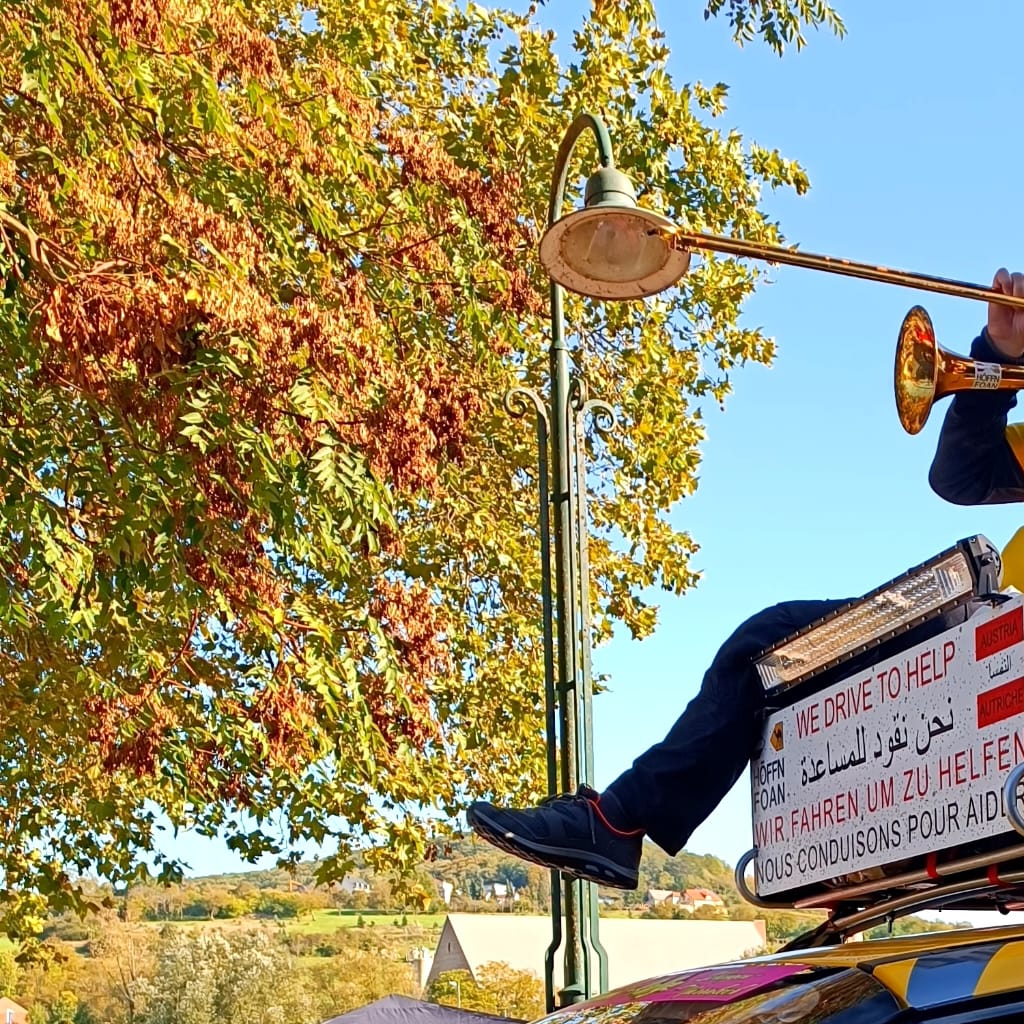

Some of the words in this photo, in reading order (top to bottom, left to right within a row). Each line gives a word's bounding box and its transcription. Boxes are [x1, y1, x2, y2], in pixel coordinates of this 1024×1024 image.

[981, 618, 1018, 648] AUSTRIA
[796, 703, 820, 739] WE
[824, 678, 873, 728] DRIVE
[877, 666, 901, 703] TO
[906, 641, 956, 692] HELP
[980, 688, 1024, 718] AUTRICHE
[916, 697, 954, 756] نحن
[754, 758, 785, 788] HÖFFN
[754, 782, 786, 813] FOAN
[755, 816, 785, 849] WIR
[791, 789, 859, 838] FAHREN
[867, 776, 894, 812] UM
[903, 764, 929, 802] ZU
[755, 852, 793, 884] NOUS
[797, 820, 901, 874] CONDUISONS
[908, 802, 960, 843] POUR
